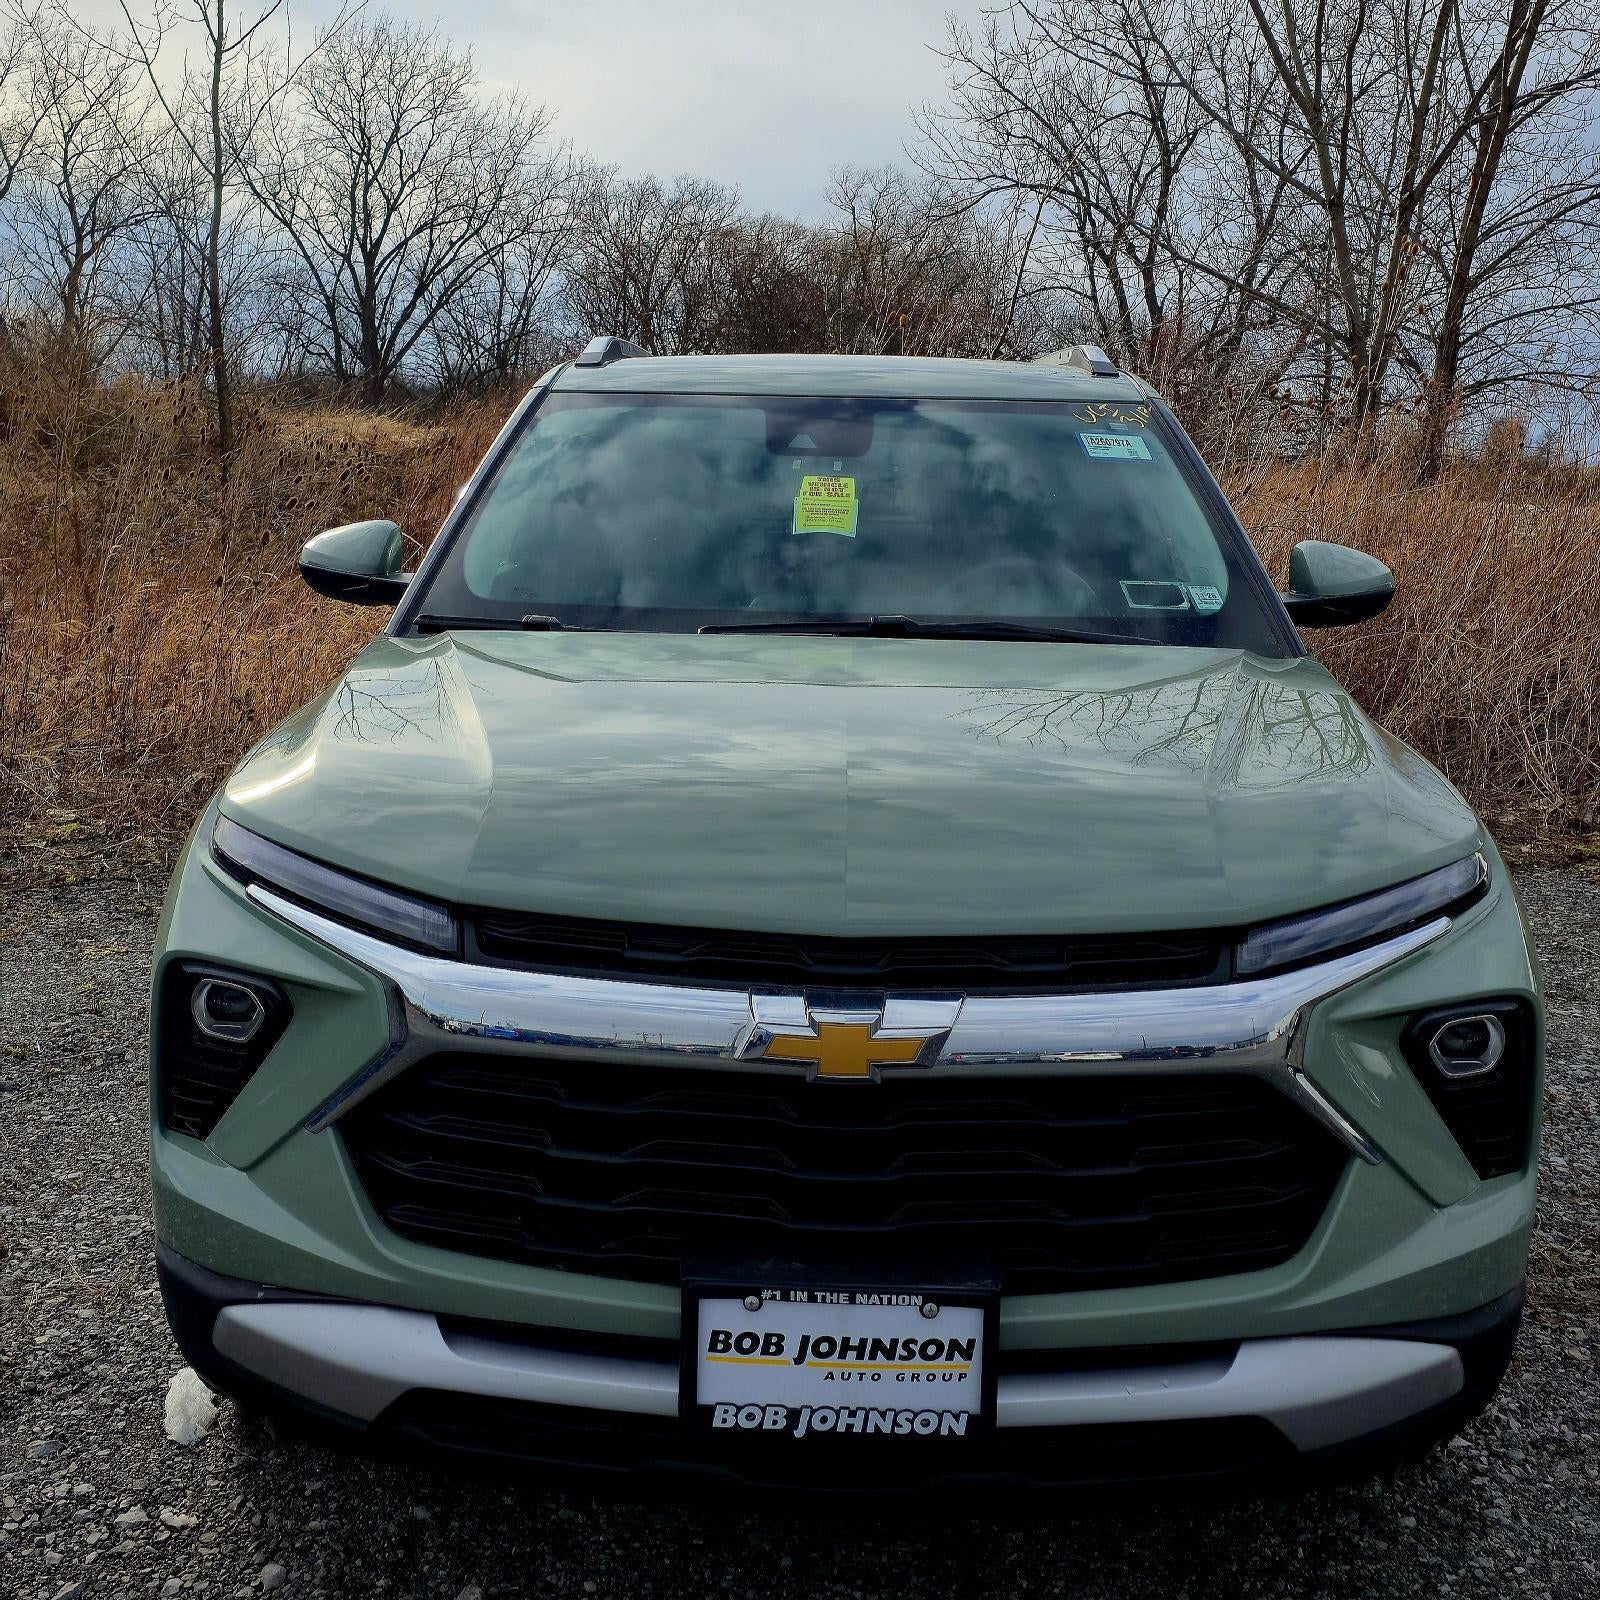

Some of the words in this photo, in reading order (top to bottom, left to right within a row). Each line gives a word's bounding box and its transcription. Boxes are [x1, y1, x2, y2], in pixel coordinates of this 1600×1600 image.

[760, 1289, 782, 1301] #1
[790, 1290, 809, 1303] IN
[814, 1291, 850, 1305] THE
[855, 1293, 923, 1307] NATION
[707, 1329, 787, 1357] BOB
[793, 1334, 977, 1366] JOHNSON
[822, 1371, 883, 1383] AUTO
[895, 1372, 969, 1383] GROUP
[712, 1403, 788, 1431] BOB
[793, 1406, 969, 1439] JOHNSON
